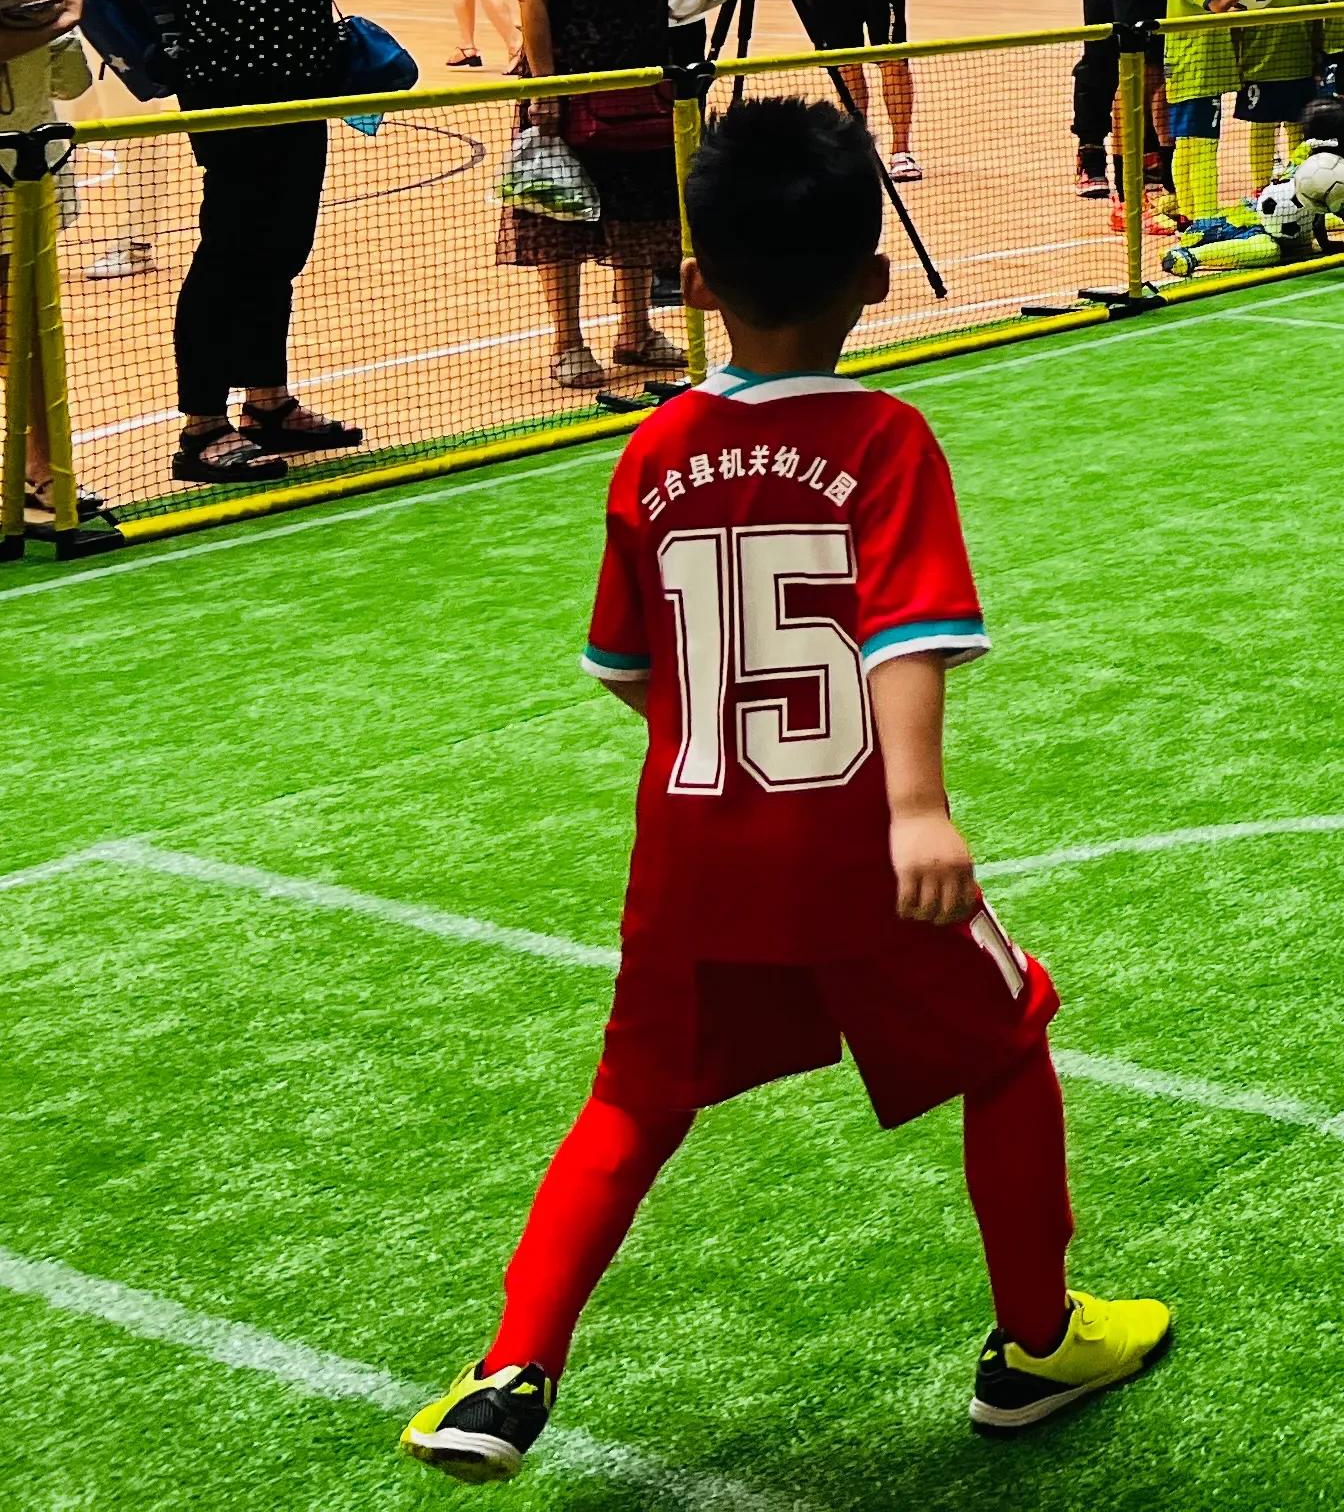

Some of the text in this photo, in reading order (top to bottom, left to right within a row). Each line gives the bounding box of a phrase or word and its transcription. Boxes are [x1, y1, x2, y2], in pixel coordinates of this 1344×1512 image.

[641, 444, 859, 522] 三台县机关幼儿园
[656, 524, 874, 796] 15
